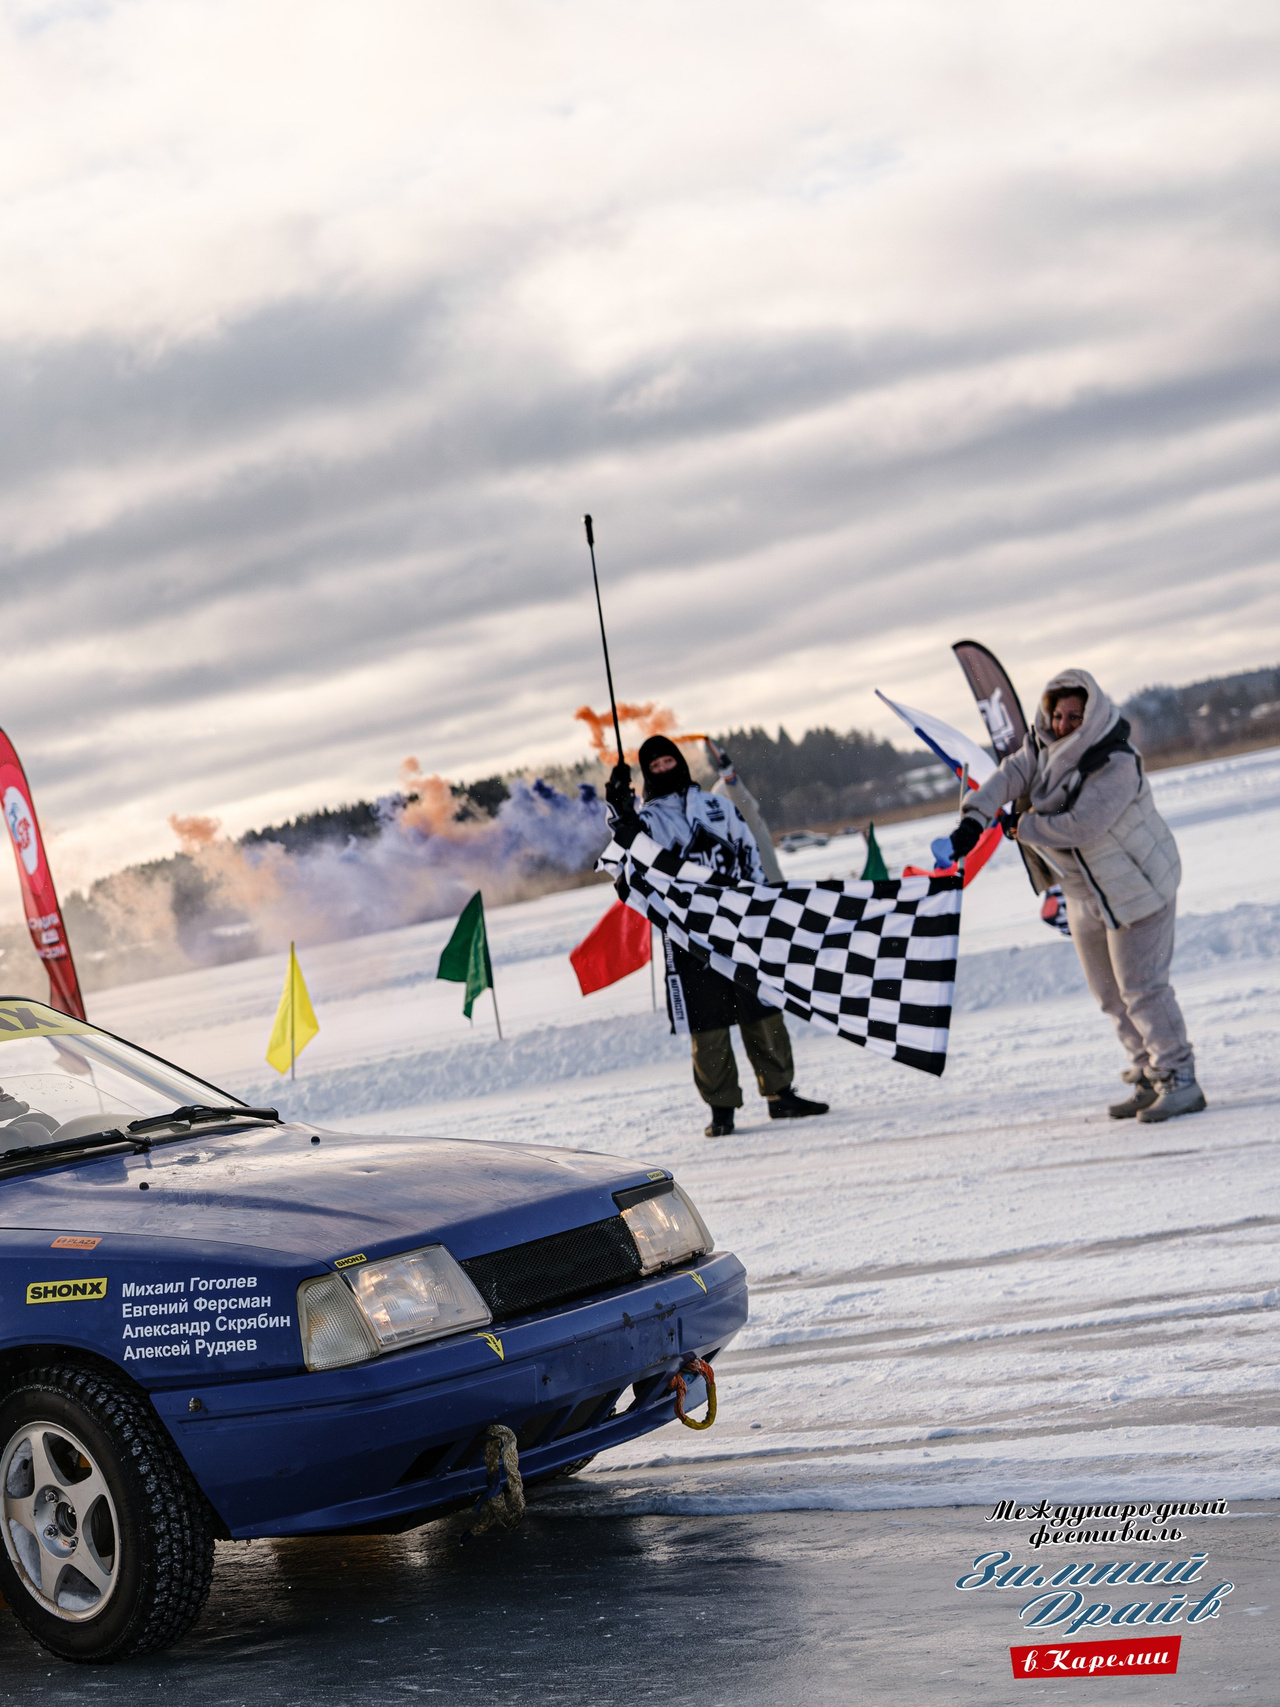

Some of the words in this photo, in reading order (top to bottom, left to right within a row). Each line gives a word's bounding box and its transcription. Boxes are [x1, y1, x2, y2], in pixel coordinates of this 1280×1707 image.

[336, 1254, 366, 1267] SHONX
[30, 1282, 103, 1299] SHONX
[122, 1281, 185, 1298] Михаил
[189, 1276, 258, 1292] Гоголев
[122, 1298, 189, 1319] Евгений
[193, 1296, 271, 1313] Ферсман
[122, 1320, 211, 1339] Александр
[215, 1313, 291, 1334] Скрябин
[123, 1340, 191, 1361] Алексей
[195, 1339, 258, 1357] Рудяев
